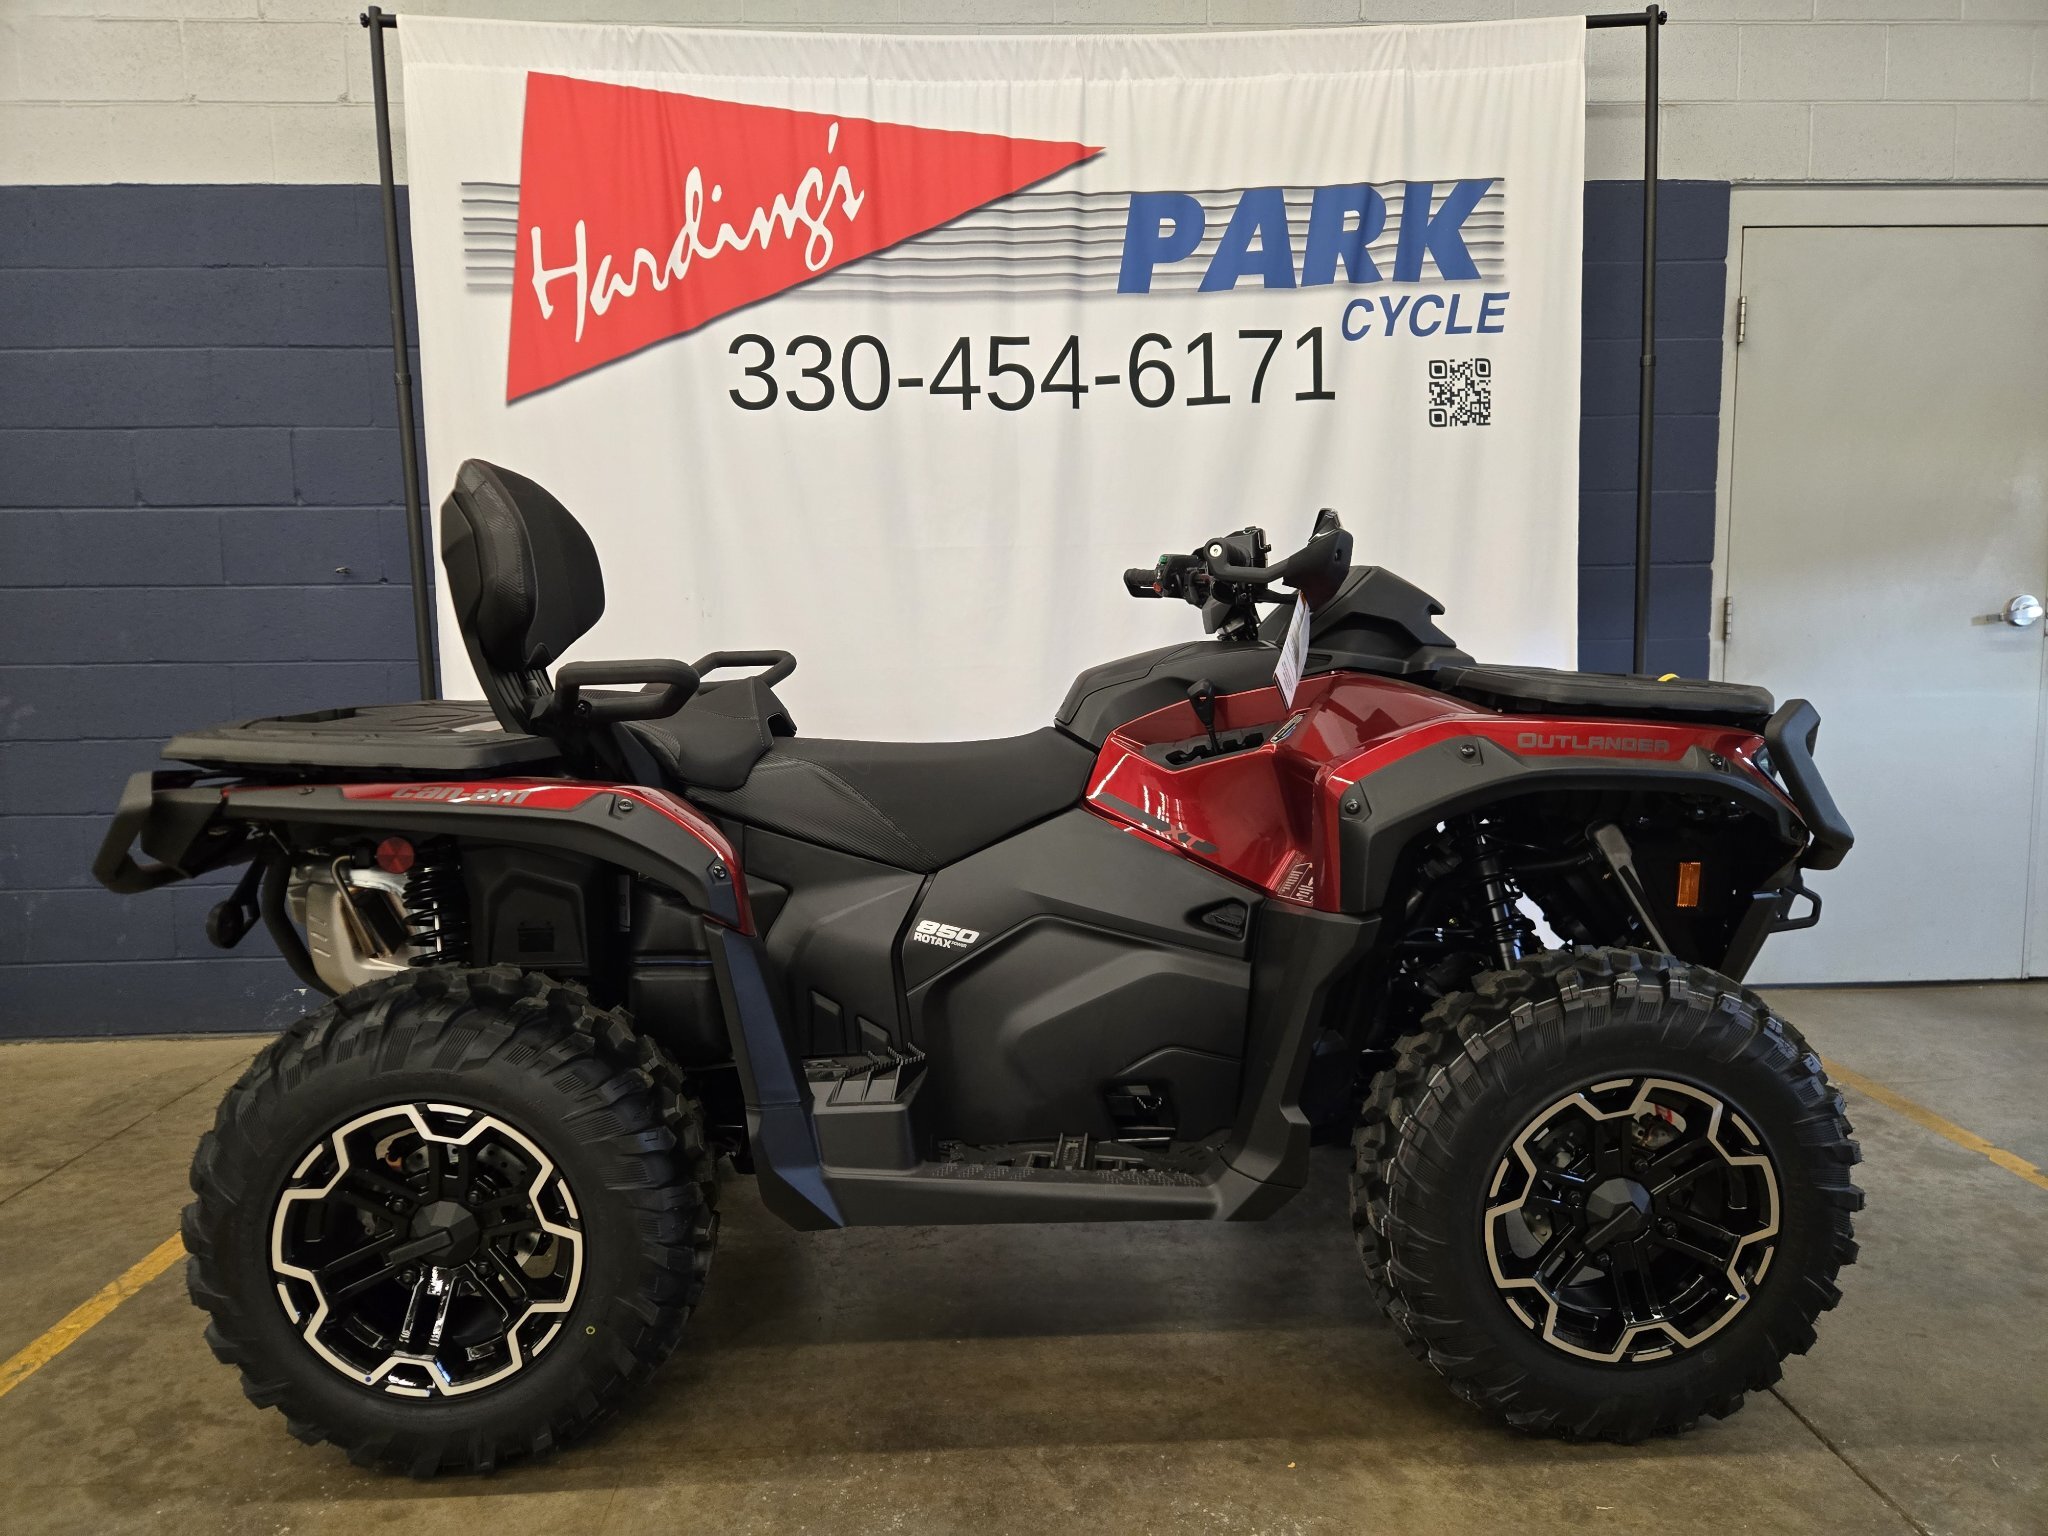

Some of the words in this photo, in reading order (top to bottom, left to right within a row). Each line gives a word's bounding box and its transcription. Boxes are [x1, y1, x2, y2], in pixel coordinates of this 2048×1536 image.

[530, 122, 864, 342] Harding's
[1117, 179, 1494, 294] PARK
[1341, 291, 1511, 342] CYCLE
[728, 326, 1336, 412] 330-454-6171
[913, 931, 951, 949] ROTAX
[915, 920, 980, 944] 850
